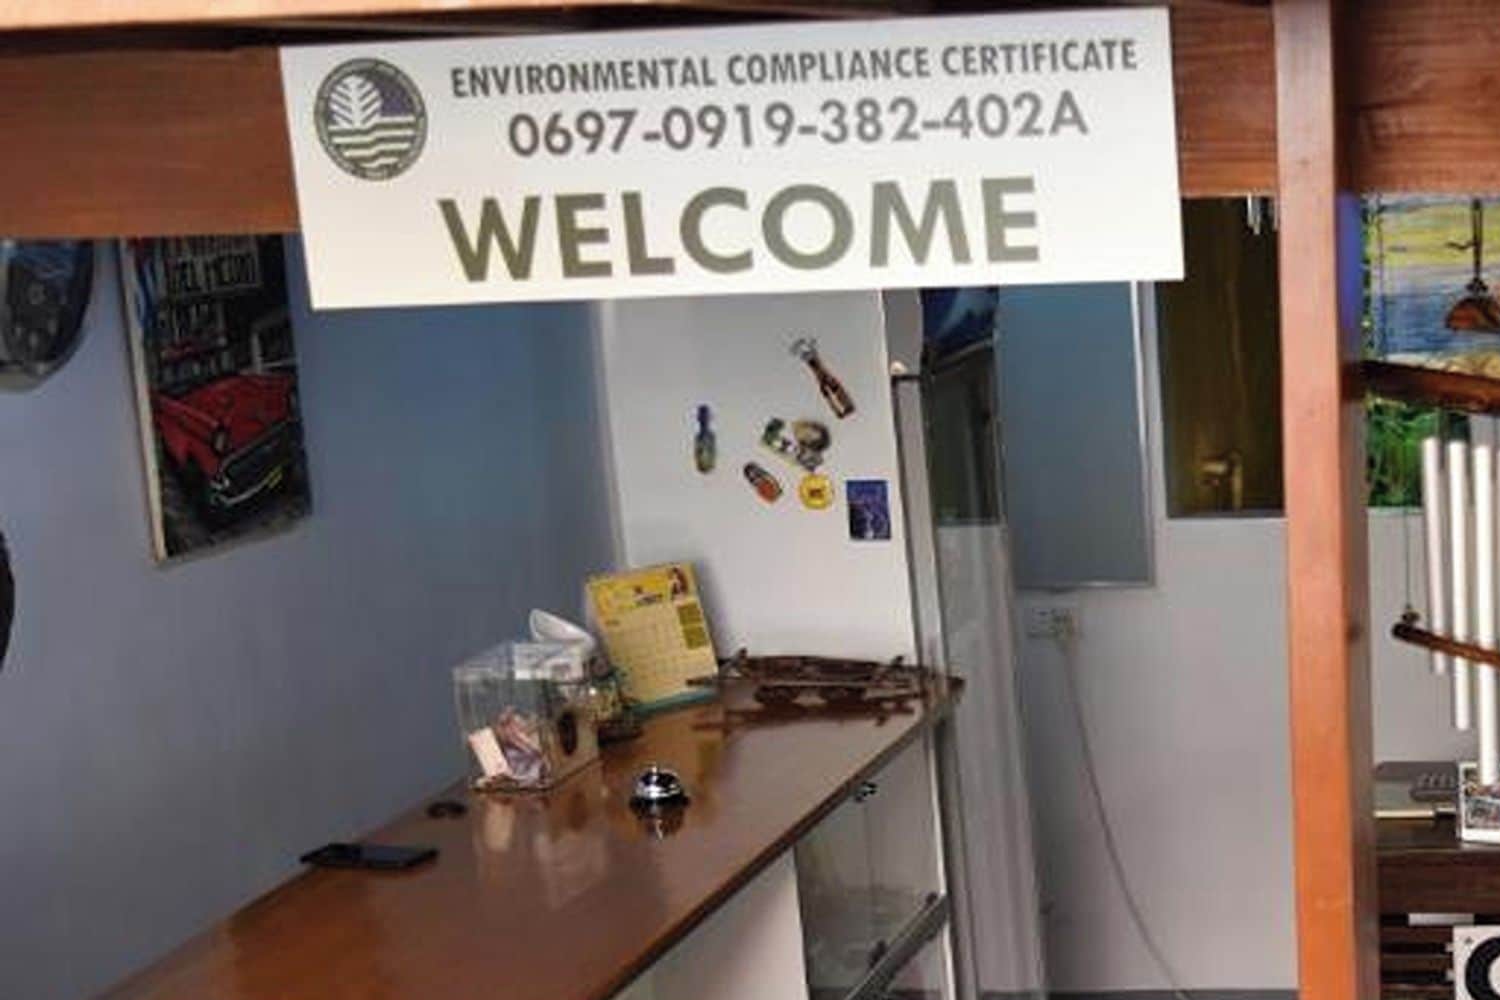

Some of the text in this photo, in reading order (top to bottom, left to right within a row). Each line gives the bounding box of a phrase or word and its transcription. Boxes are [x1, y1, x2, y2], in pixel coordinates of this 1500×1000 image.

[451, 38, 1138, 97] ENVIRONMENTAL COMPLIANCE CERTIFICATE
[508, 90, 1089, 157] 0697-0919-382-402A
[438, 176, 1040, 282] WELCOME
